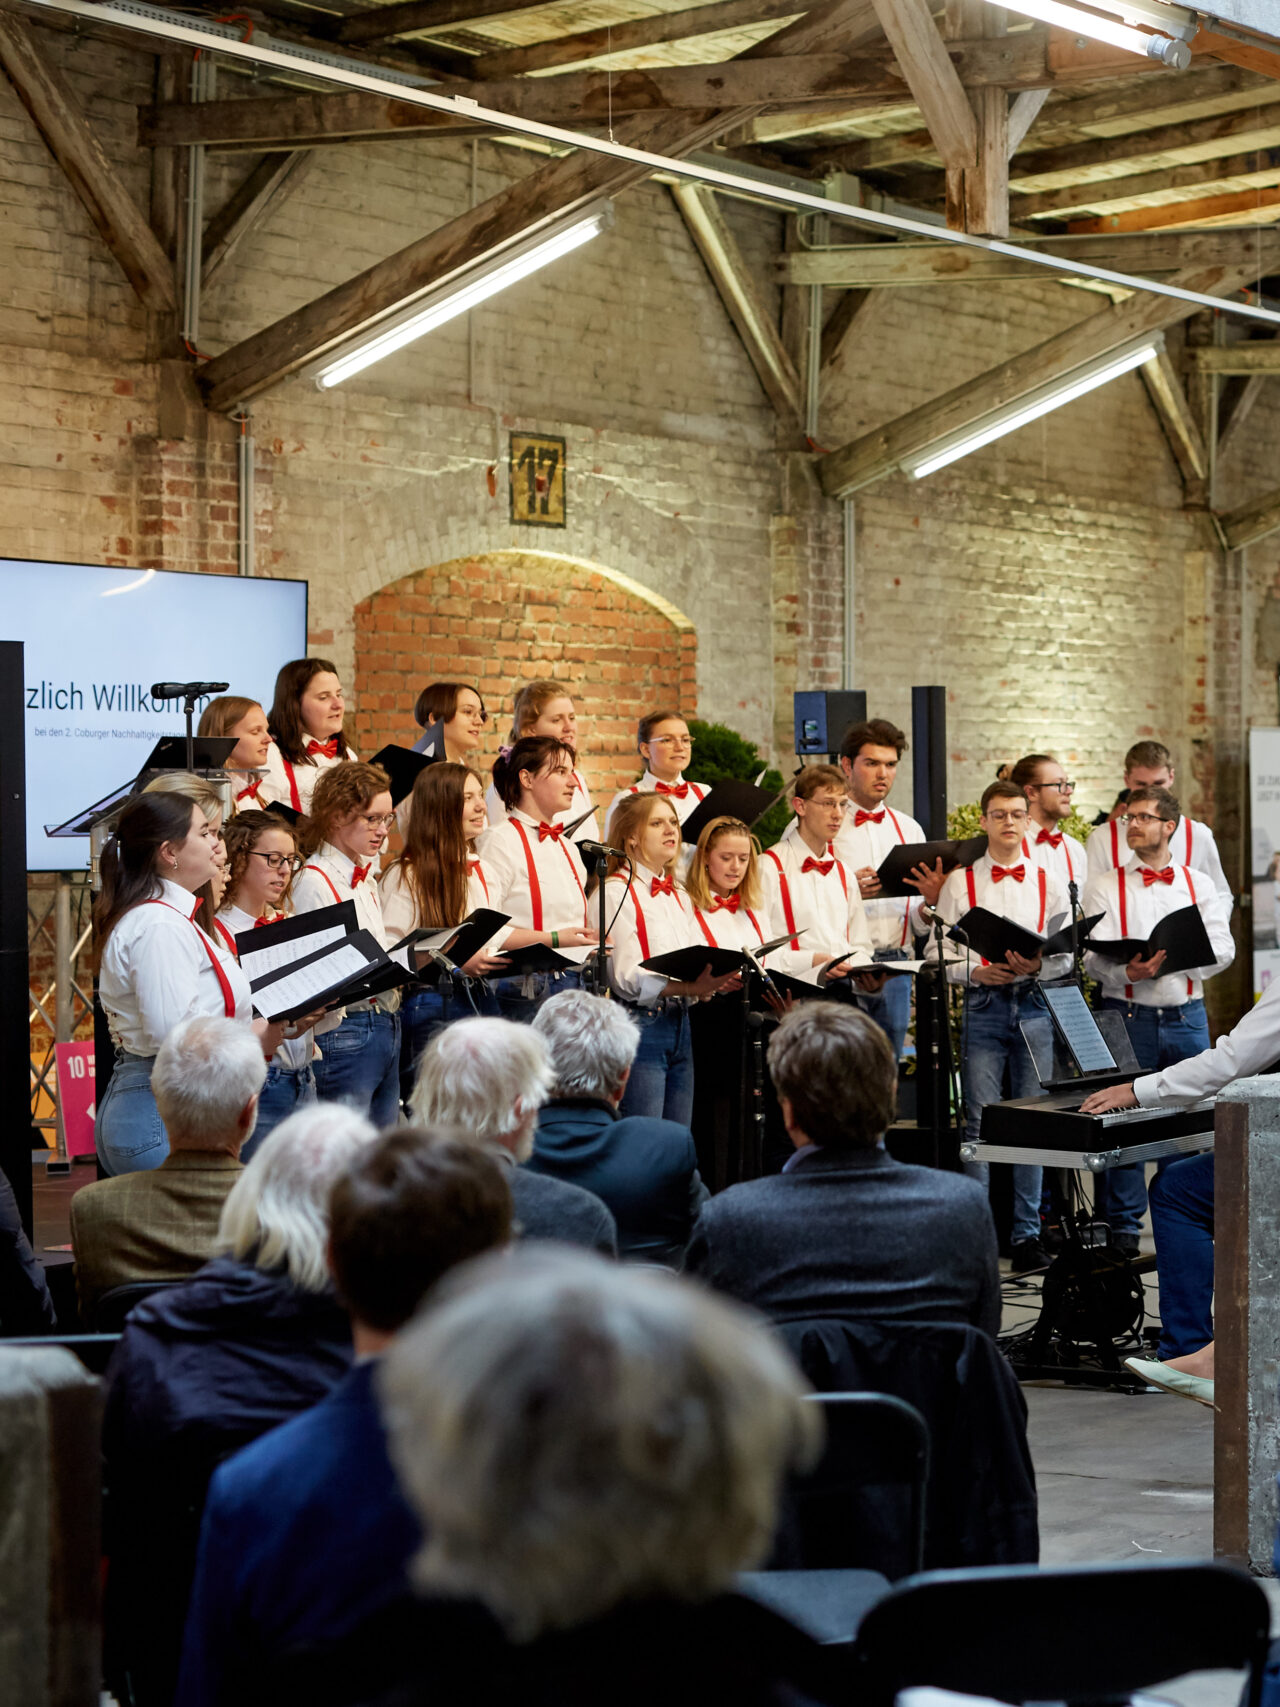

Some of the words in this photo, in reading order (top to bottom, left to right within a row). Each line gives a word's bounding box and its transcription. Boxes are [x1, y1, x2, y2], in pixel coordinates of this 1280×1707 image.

[517, 445, 559, 515] 17
[34, 727, 47, 737] bei
[48, 727, 63, 737] den
[74, 728, 110, 741] Coburger
[67, 1055, 85, 1079] 10
